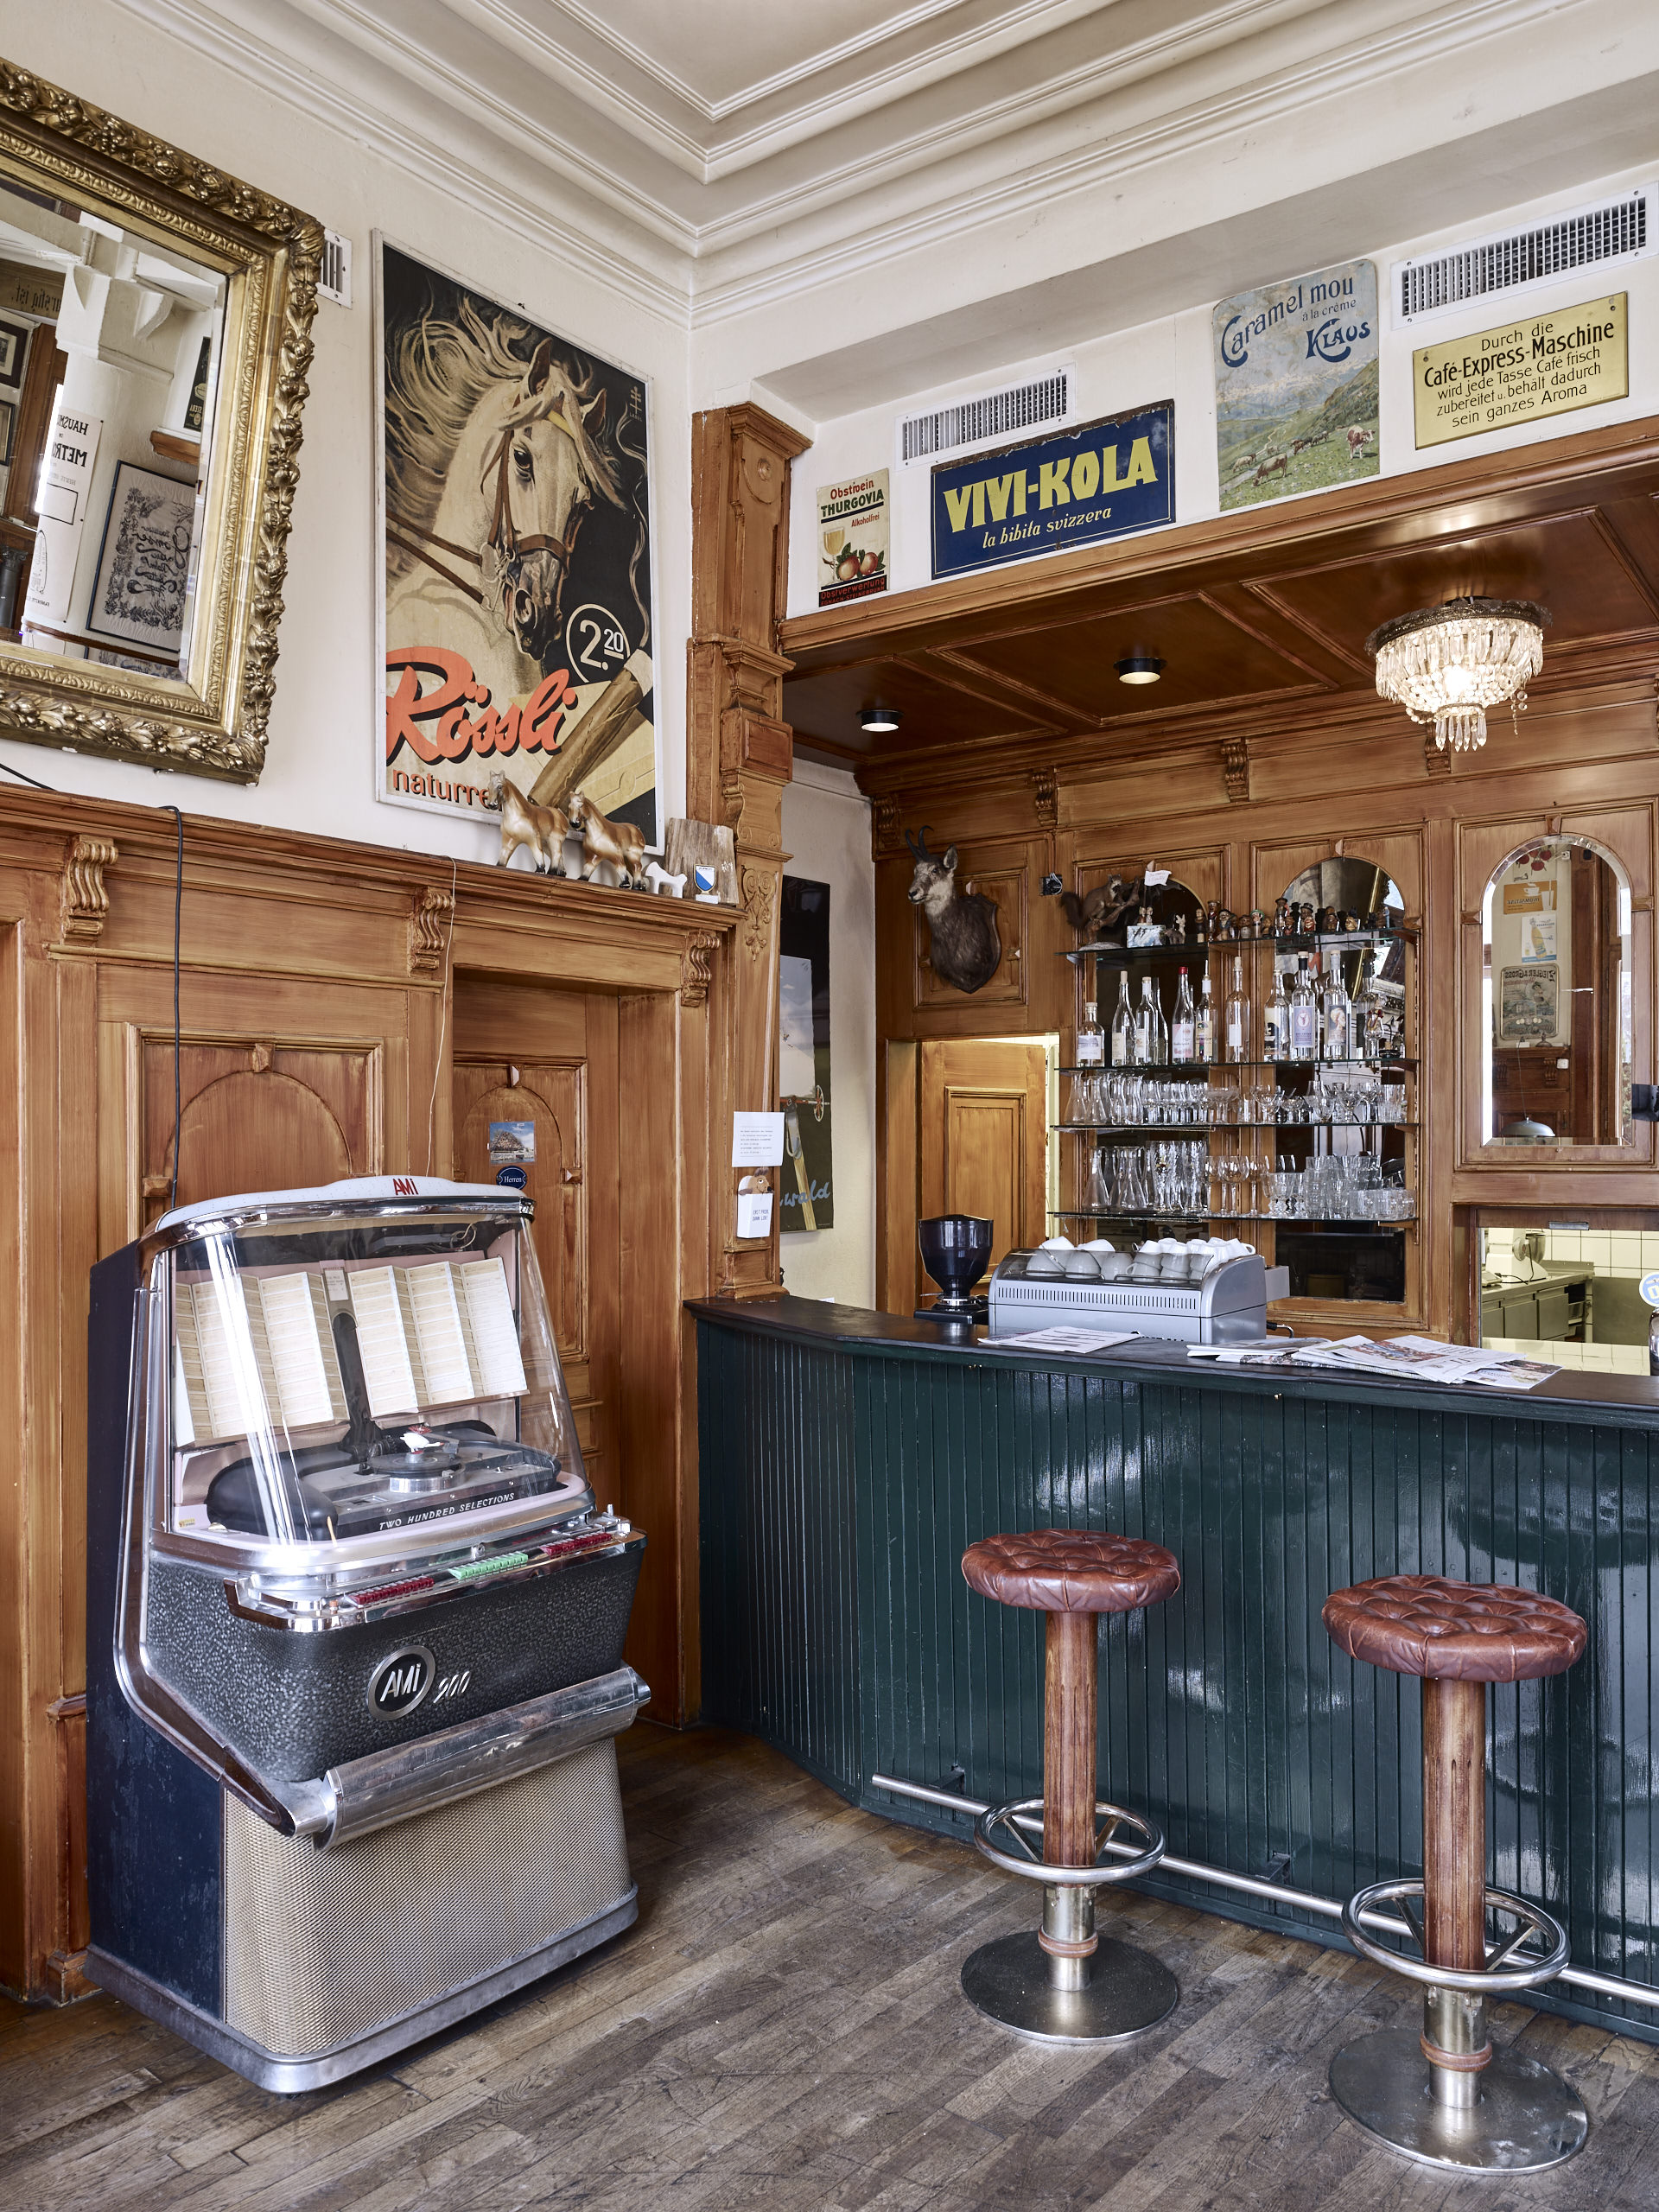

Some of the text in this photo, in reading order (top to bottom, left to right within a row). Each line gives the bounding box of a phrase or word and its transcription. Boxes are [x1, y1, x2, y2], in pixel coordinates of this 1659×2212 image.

[1221, 276, 1353, 368] Caramel mou
[1311, 307, 1319, 320] la
[1306, 318, 1370, 363] KLAUS
[1424, 322, 1614, 387] Café-Express-Maschine
[1481, 322, 1554, 351] Durch die
[1437, 390, 1495, 416] zubereitet
[1508, 376, 1545, 397] behält
[1551, 362, 1601, 385] dadurch
[1438, 346, 1600, 400] wird jede Tasse Café frisch
[1452, 410, 1479, 428] sein
[1487, 398, 1535, 423] ganzes
[1541, 384, 1587, 404] Aroma
[821, 489, 884, 517] THURGOVIA
[830, 480, 874, 500] Obstwein
[943, 435, 1159, 532] VIVI-KOLA
[851, 512, 880, 527] Alkoholfrei
[982, 507, 1111, 549] la bibita svizzera
[821, 576, 885, 599] Obstverwertung
[386, 646, 578, 766] Rössli
[392, 769, 494, 810] naturre
[379, 1492, 515, 1530] TWO HUNDRED SELECTIONS
